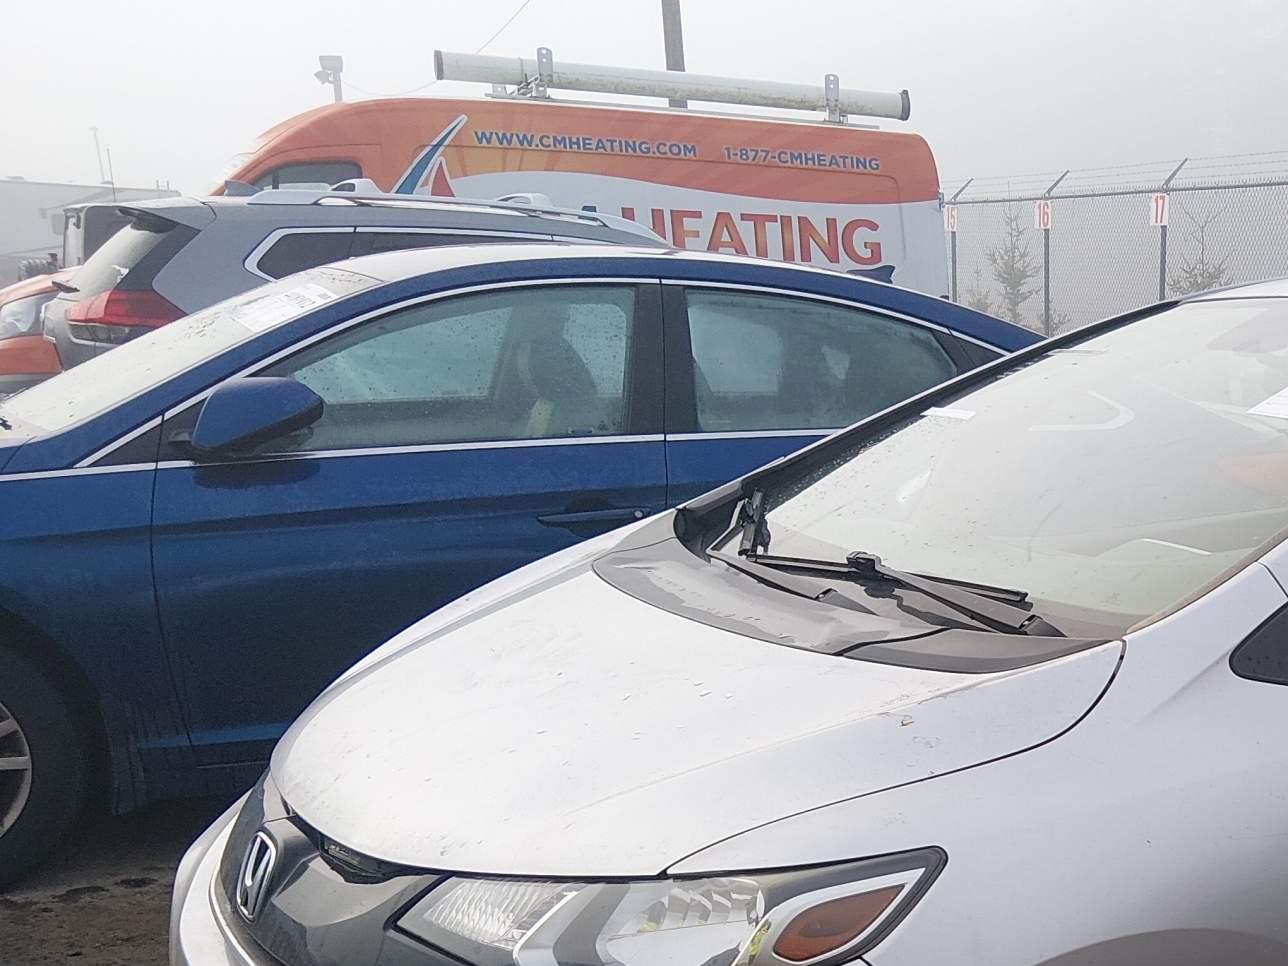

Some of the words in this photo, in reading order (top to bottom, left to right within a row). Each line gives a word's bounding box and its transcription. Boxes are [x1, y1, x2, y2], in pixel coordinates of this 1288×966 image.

[474, 130, 697, 158] WWW.CMHEATING.COM
[724, 147, 880, 170] 1-877-CMHEATING
[1038, 202, 1049, 228] 16
[1154, 195, 1166, 224] 17
